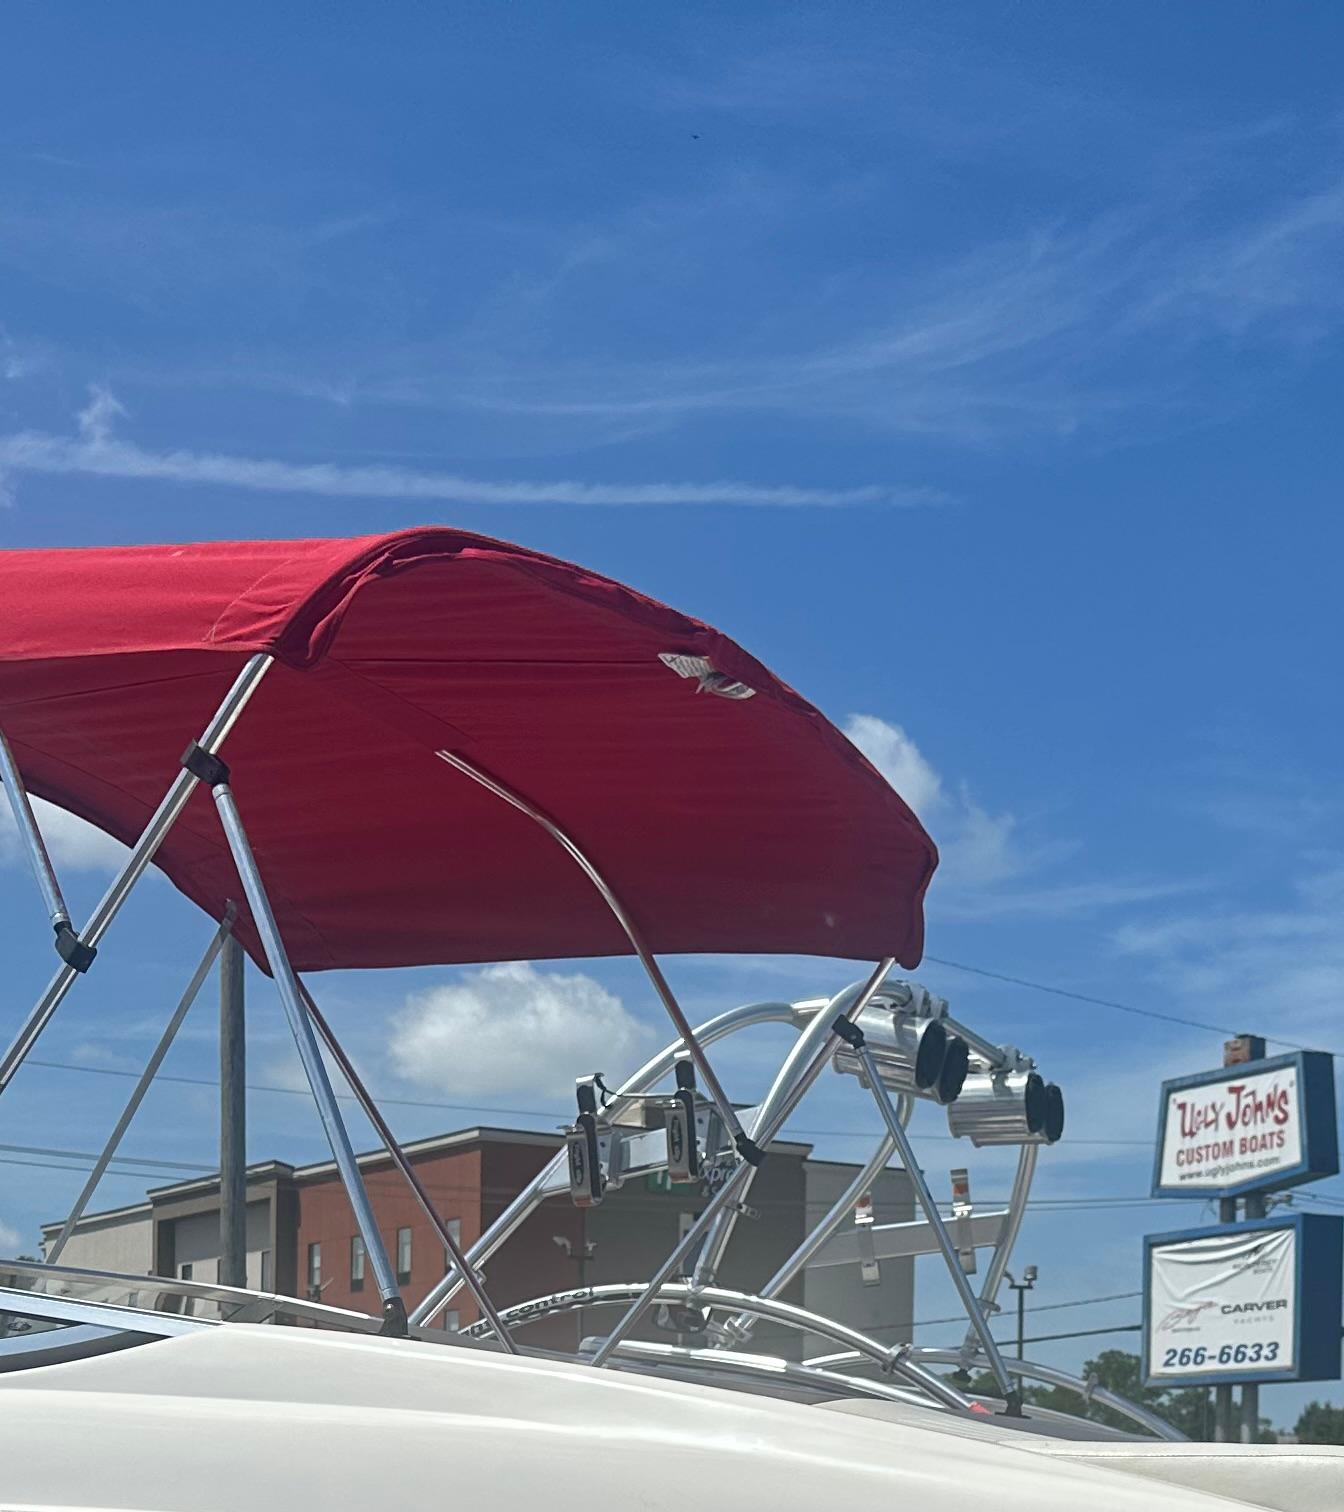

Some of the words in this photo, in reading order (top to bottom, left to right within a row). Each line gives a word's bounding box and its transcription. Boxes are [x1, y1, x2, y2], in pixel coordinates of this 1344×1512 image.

[1176, 1140, 1233, 1167] CUSTOM
[1239, 1130, 1285, 1155] BOATS
[1179, 1157, 1280, 1180] www.uglyjohns.com
[1221, 1299, 1288, 1314] CARVER
[1163, 1342, 1280, 1368] 266-6633
